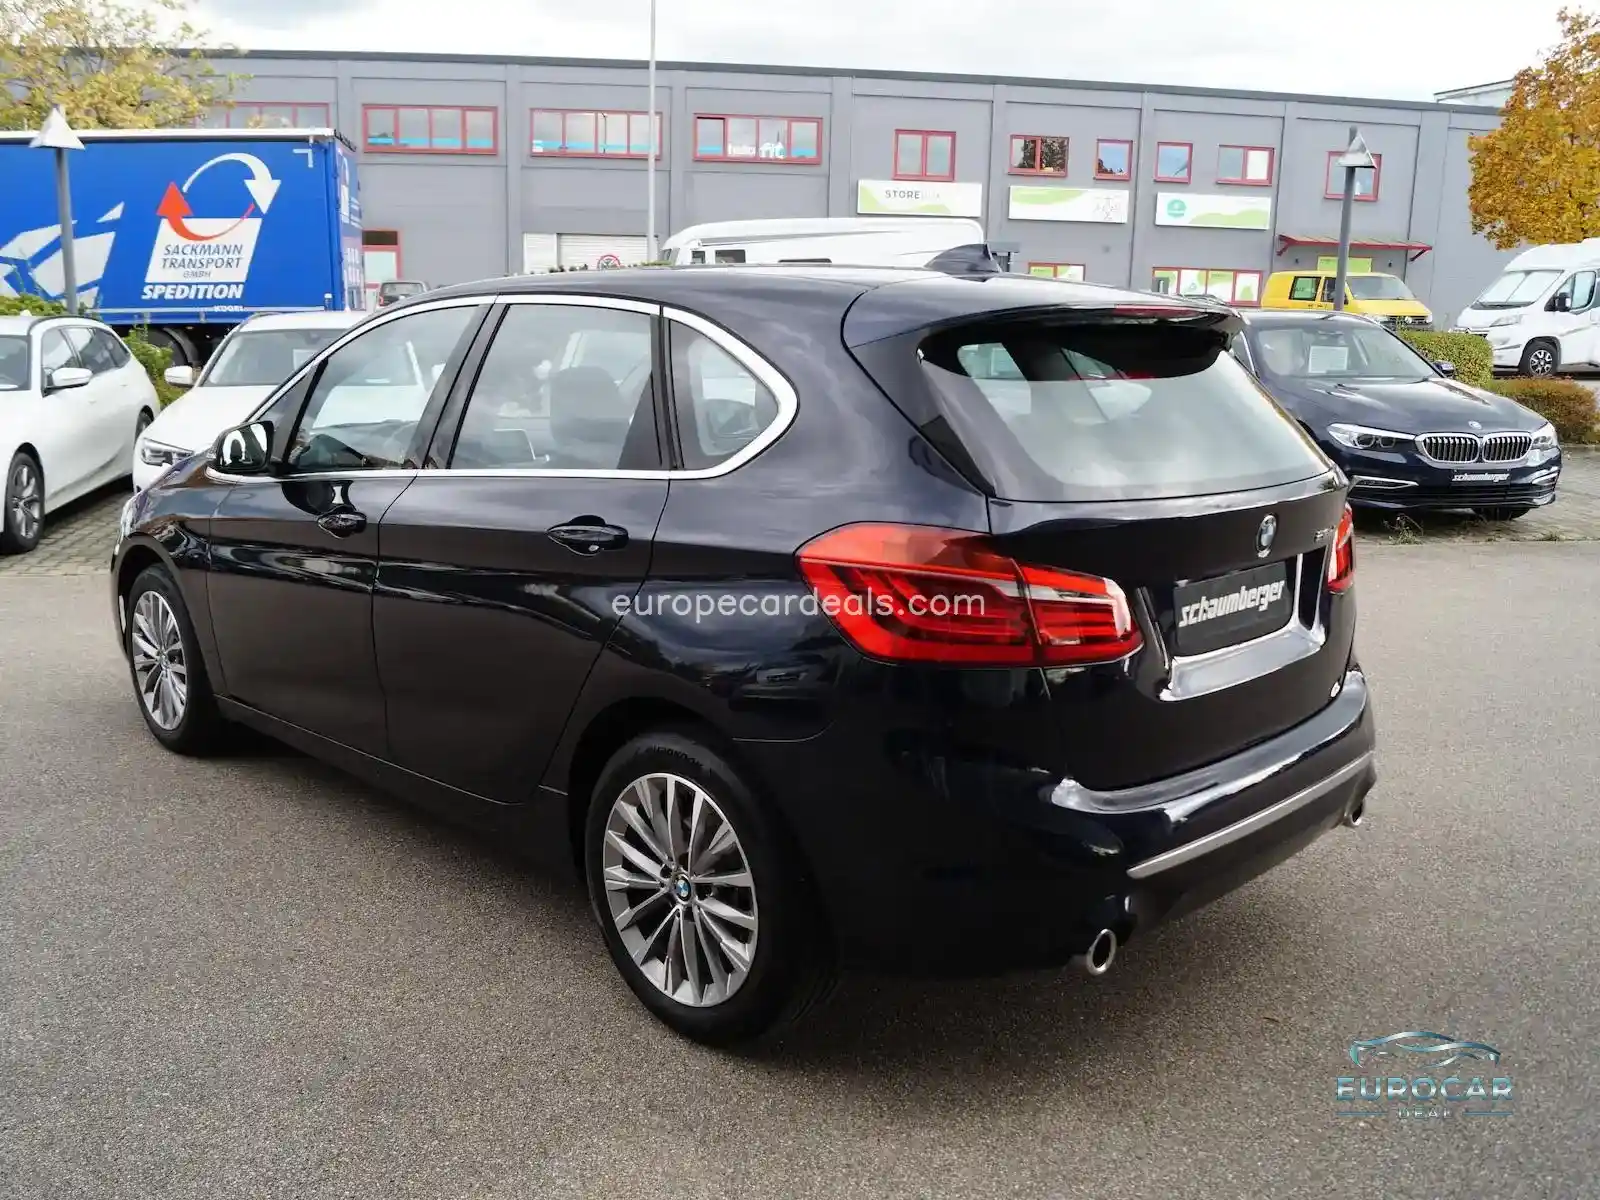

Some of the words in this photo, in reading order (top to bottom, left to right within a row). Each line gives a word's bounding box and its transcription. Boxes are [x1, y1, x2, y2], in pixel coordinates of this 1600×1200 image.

[885, 189, 940, 200] STORE
[164, 244, 243, 256] SACKMANN
[161, 257, 243, 269] TRANSPORT
[141, 284, 244, 300] SPEDITION
[1178, 580, 1285, 628] schaumberger
